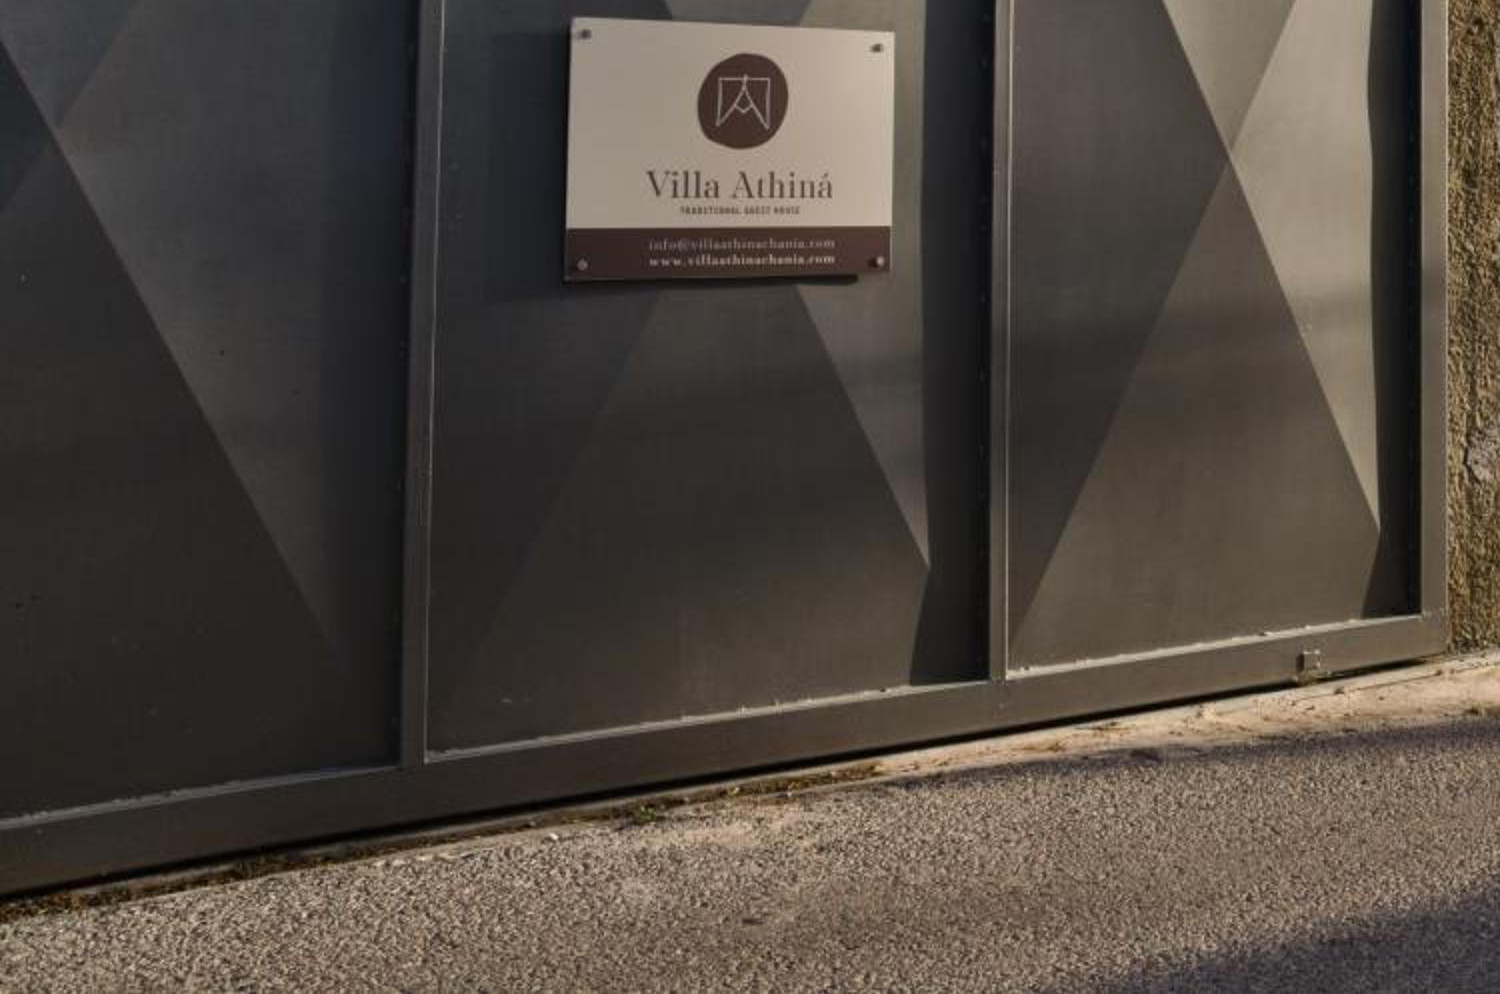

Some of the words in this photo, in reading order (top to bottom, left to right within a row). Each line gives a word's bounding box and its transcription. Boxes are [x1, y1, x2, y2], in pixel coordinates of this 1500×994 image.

[646, 169, 720, 199] Villa
[731, 170, 833, 199] Athiná
[680, 205, 741, 215] TRADITIONAL
[743, 205, 771, 215] GUEST
[773, 205, 800, 215] HOUSE
[649, 253, 835, 267] www.villaathinachania.com
